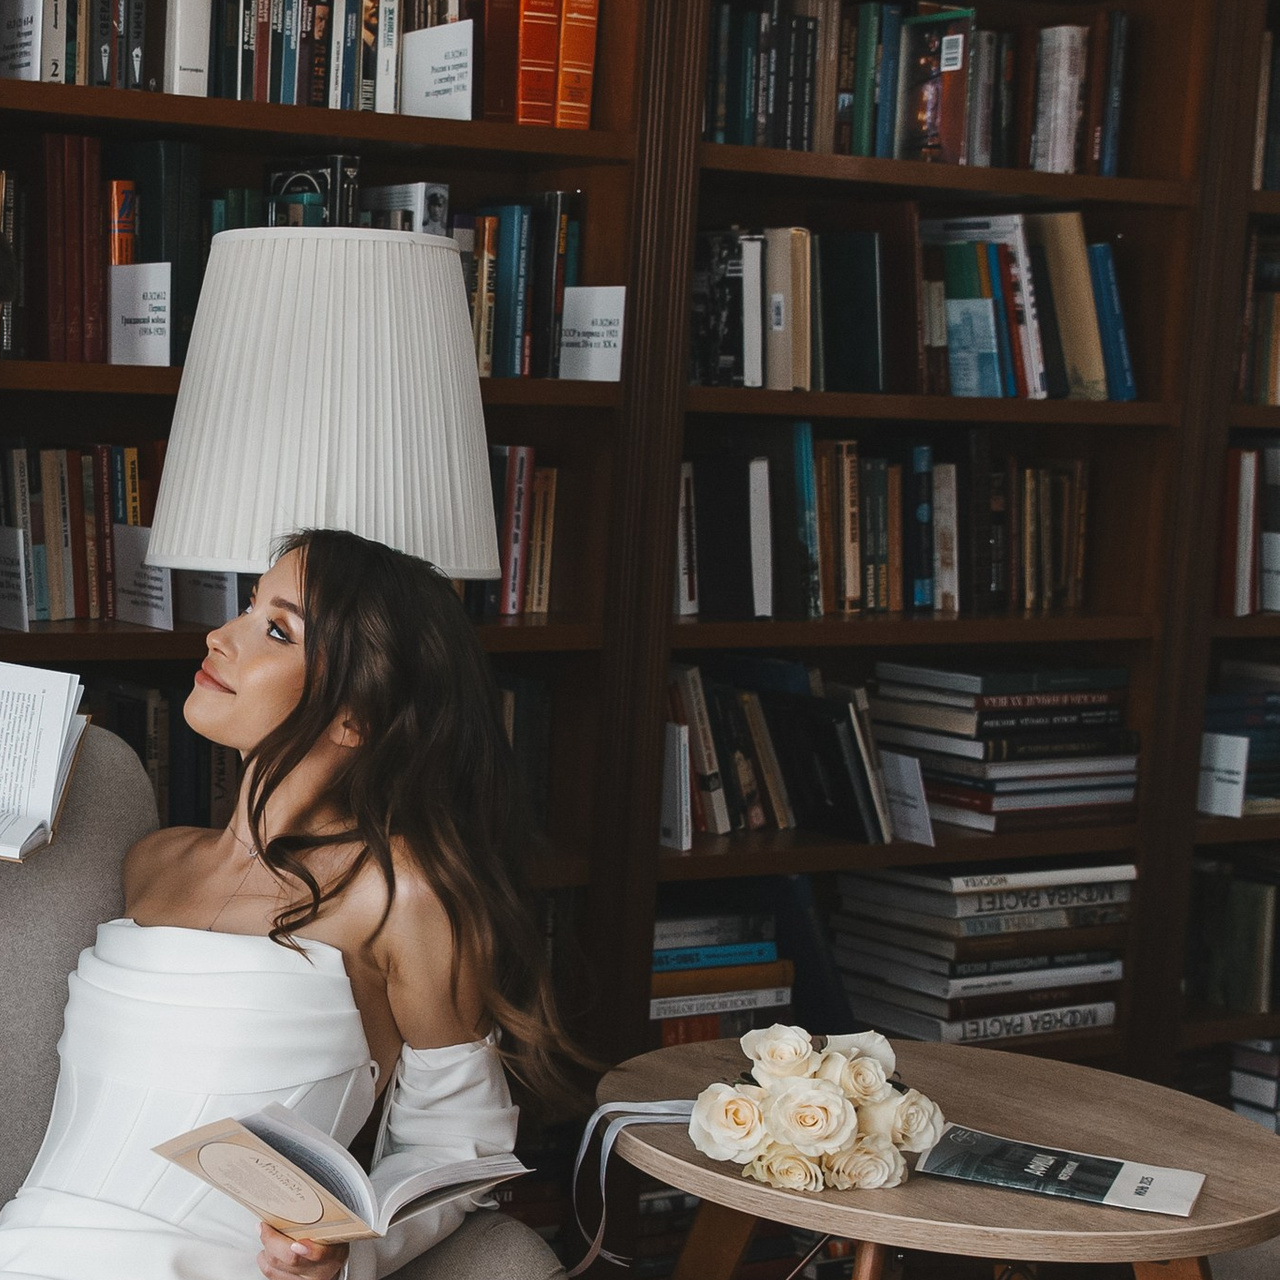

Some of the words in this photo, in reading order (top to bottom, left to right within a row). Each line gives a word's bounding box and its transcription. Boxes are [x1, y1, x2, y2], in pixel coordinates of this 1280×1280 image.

[129, 459, 138, 494] ВОЙНА
[975, 888, 1038, 912] РАСТЕТ
[958, 1014, 1019, 1041] РАСТЕТ
[1023, 1153, 1058, 1177] АФИША
[1144, 1175, 1154, 1186] 2025
